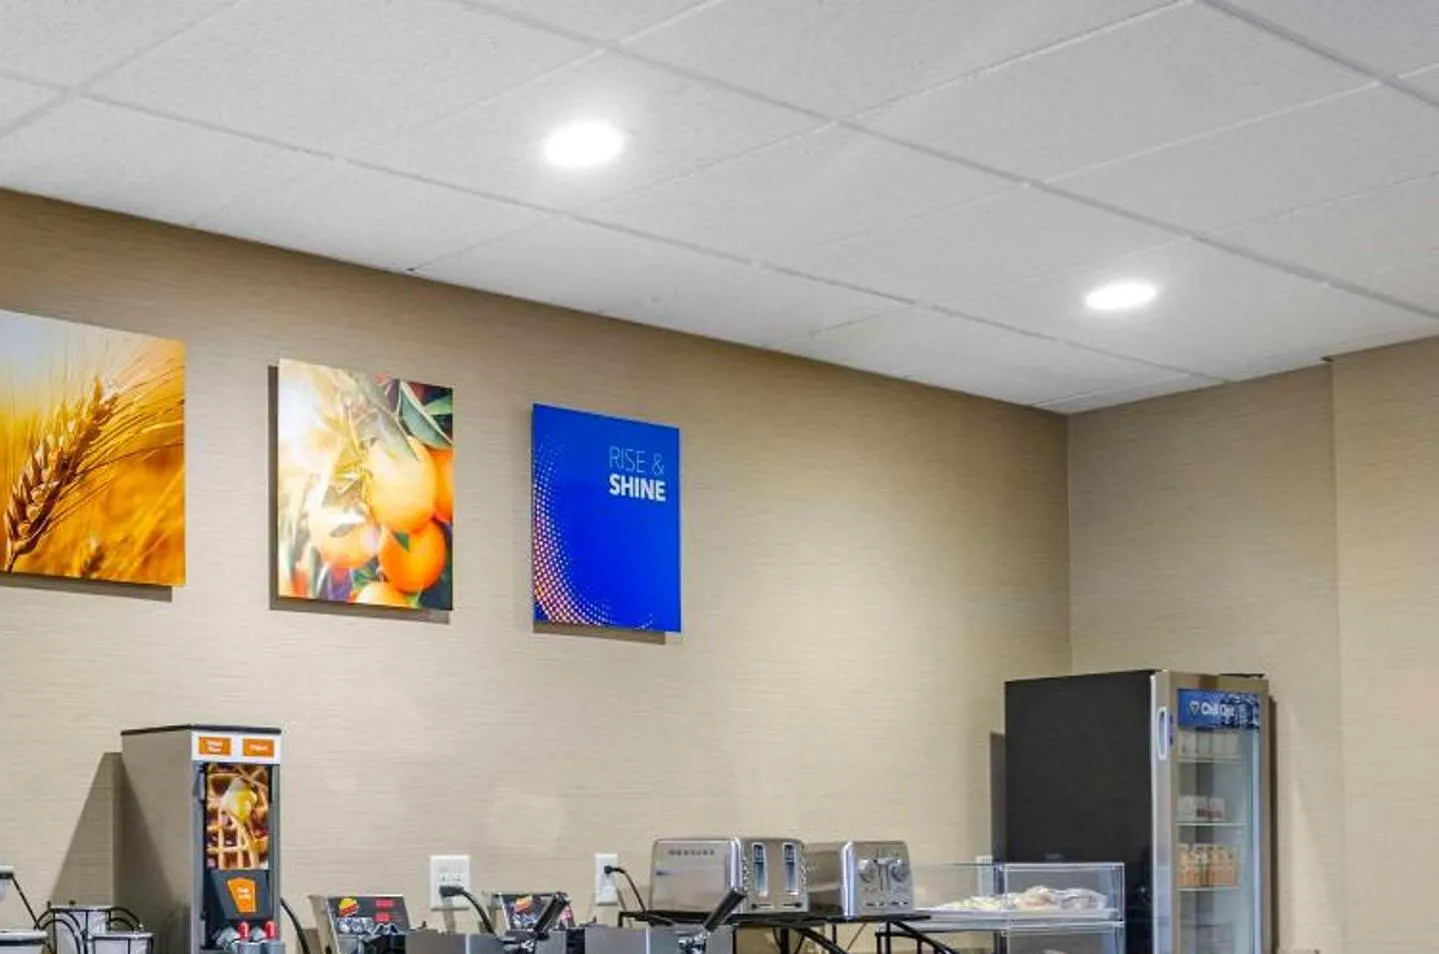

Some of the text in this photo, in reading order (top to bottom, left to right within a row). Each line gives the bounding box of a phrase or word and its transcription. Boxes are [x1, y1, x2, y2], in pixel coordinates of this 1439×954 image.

[609, 446, 665, 476] RISE &
[609, 473, 666, 502] SHINE
